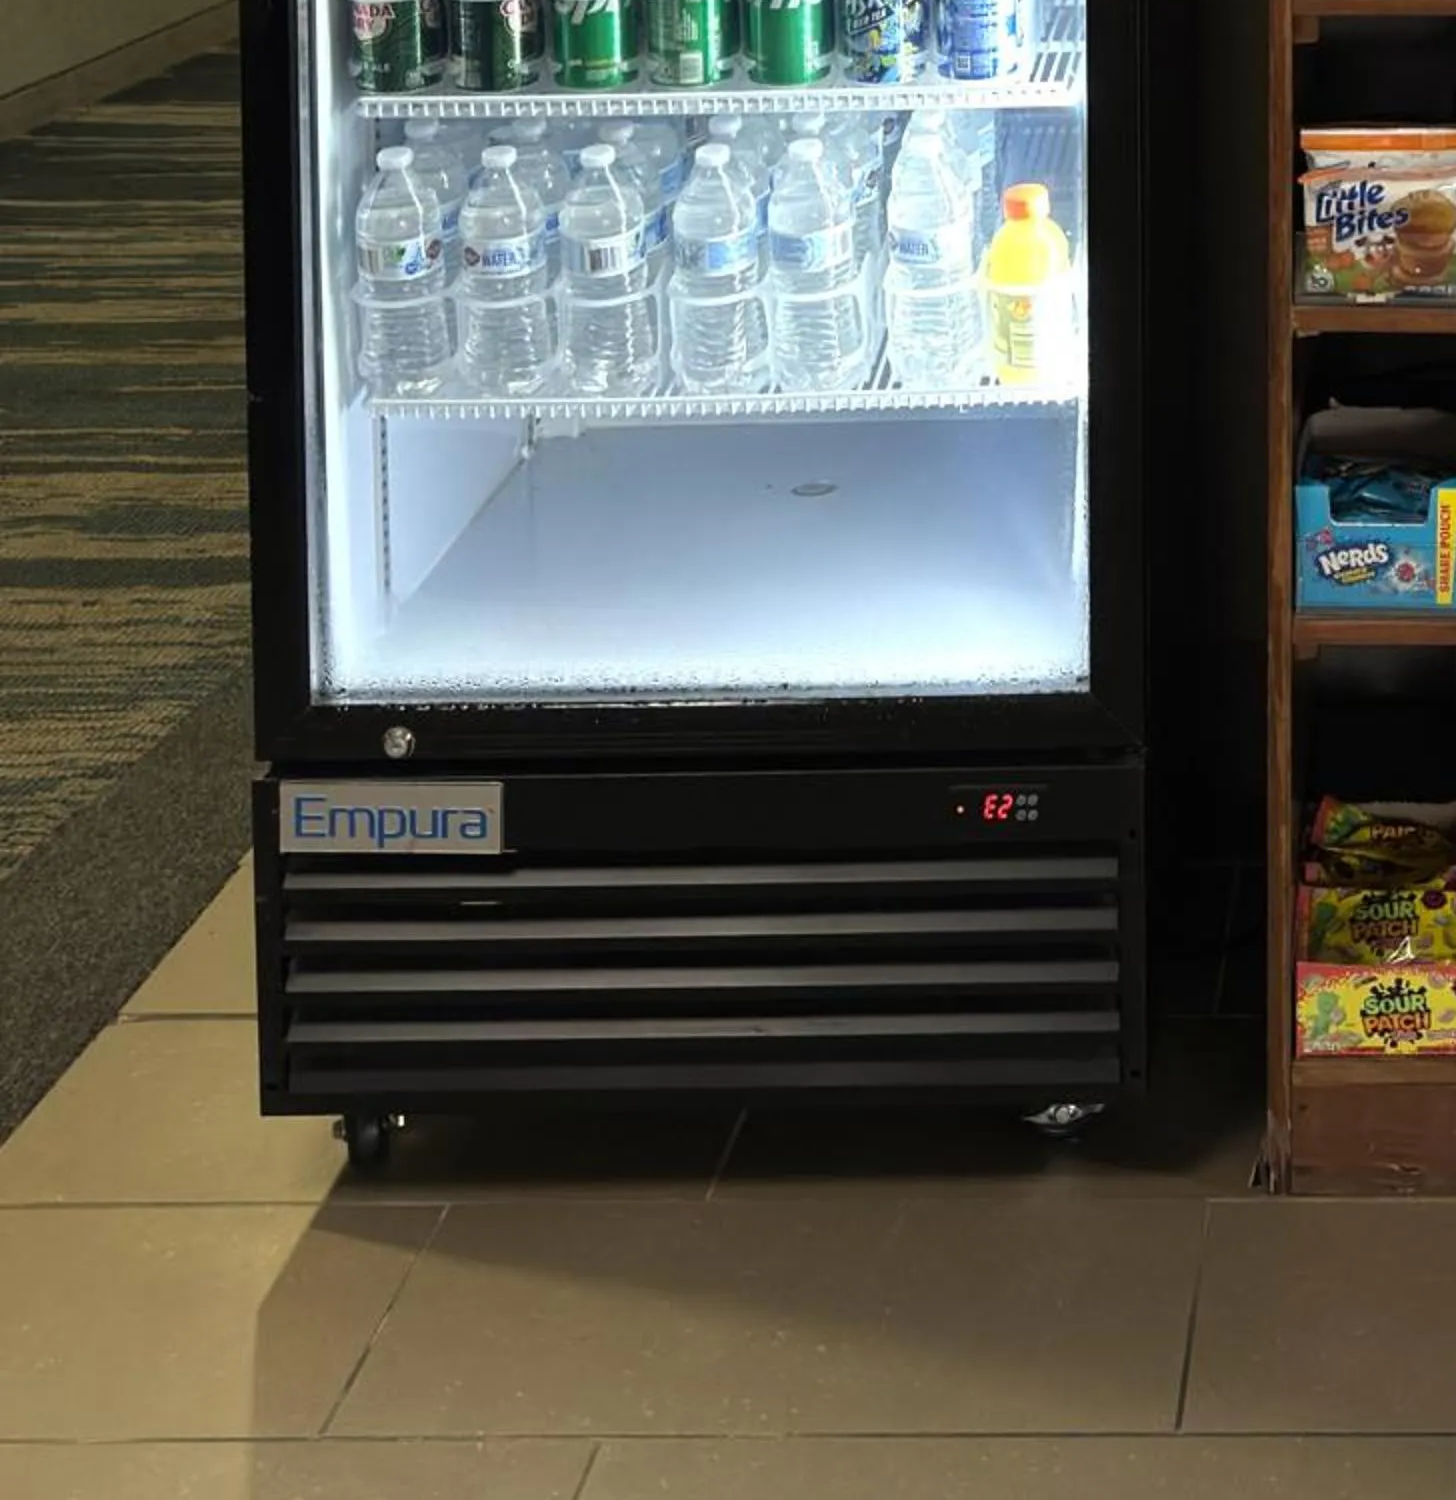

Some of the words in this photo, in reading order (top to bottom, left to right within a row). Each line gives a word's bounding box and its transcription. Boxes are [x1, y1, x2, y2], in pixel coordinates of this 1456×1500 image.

[1315, 180, 1385, 224] Little
[1333, 205, 1409, 243] Bites
[1440, 505, 1451, 549] POUCH
[294, 796, 488, 849] Empura
[1356, 901, 1415, 920] SOUR
[1353, 919, 1418, 939] PATCH
[1365, 995, 1426, 1015] SOUR
[1365, 1012, 1430, 1030] PATCH
